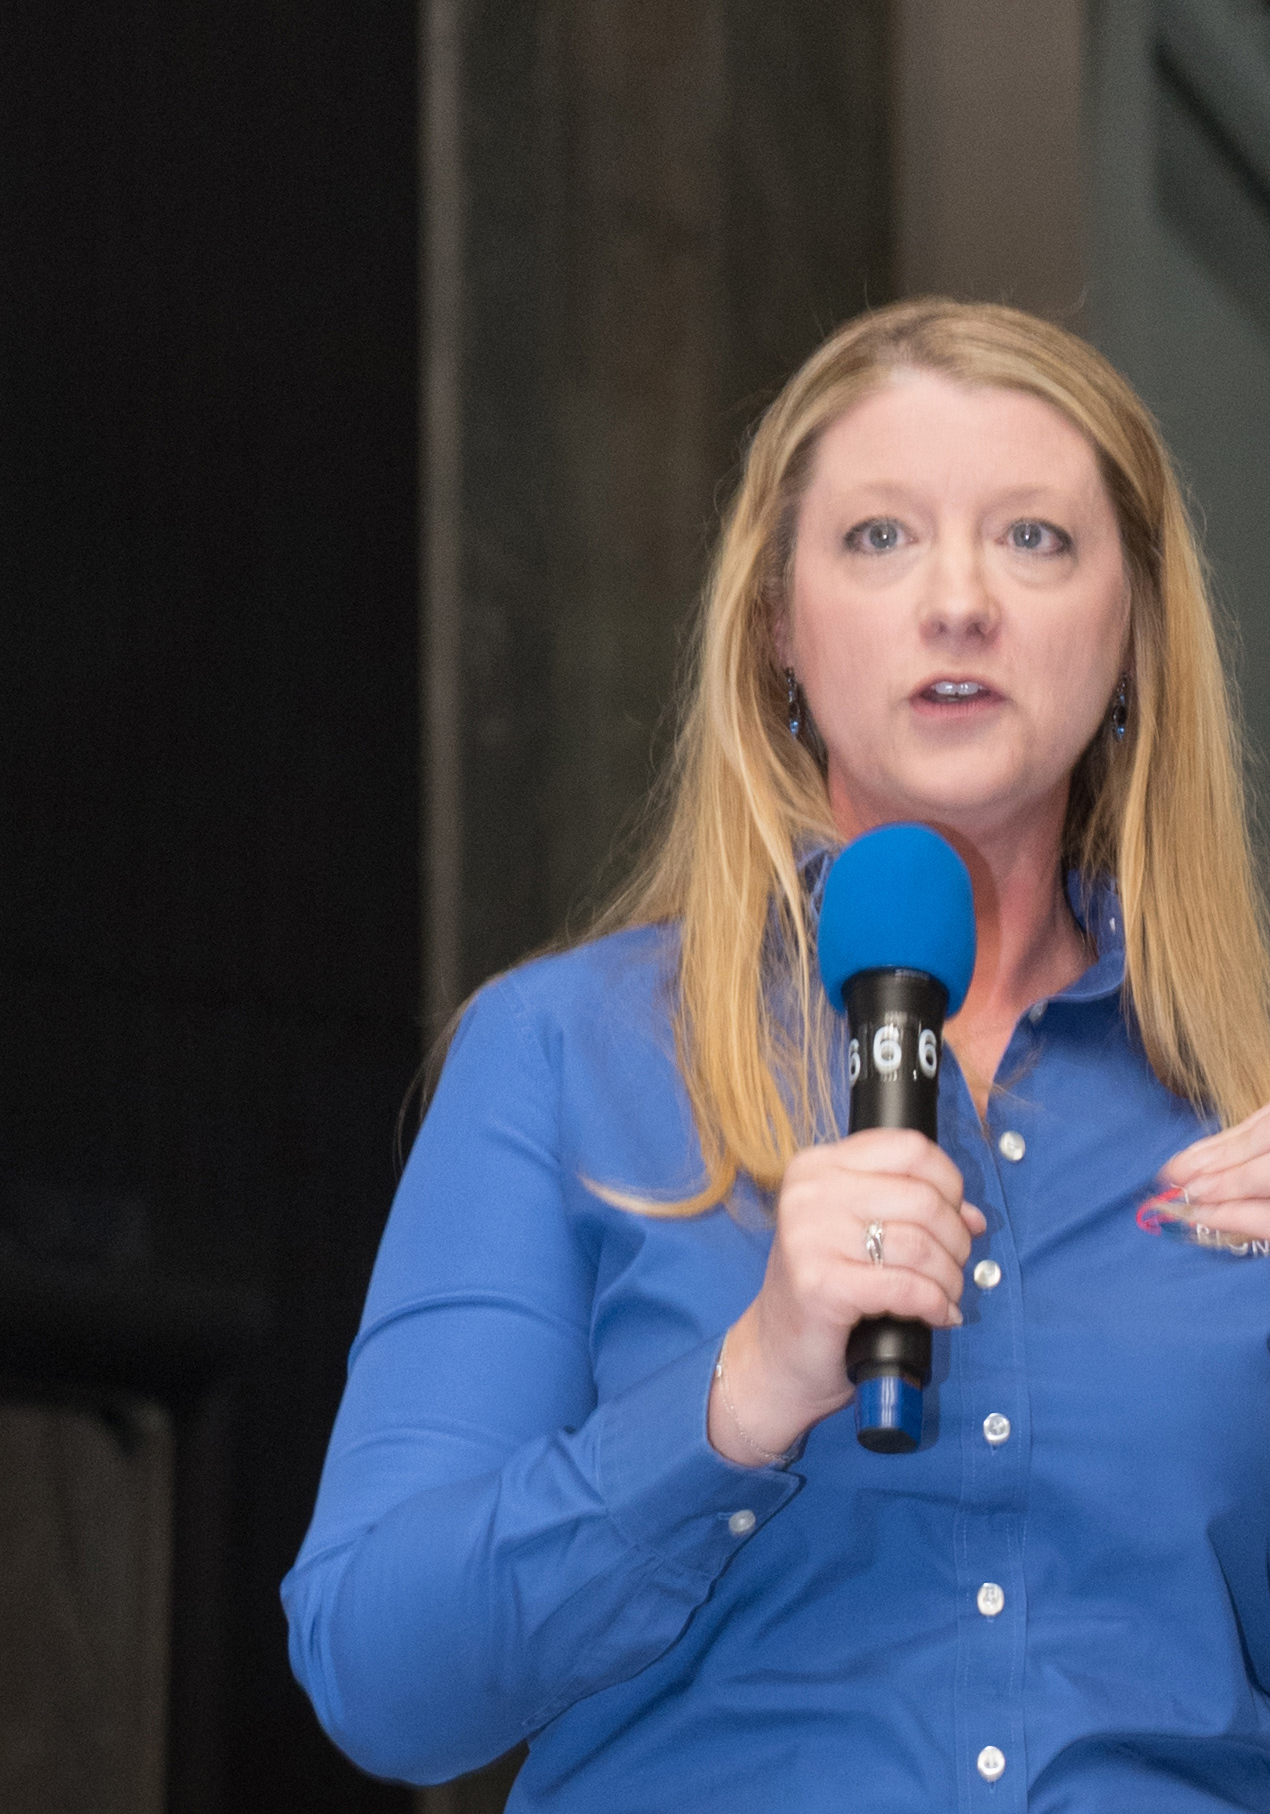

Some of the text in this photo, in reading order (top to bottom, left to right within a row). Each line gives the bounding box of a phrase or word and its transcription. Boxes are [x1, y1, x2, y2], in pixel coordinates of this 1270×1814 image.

[849, 1025, 937, 1085] 6 6 6
